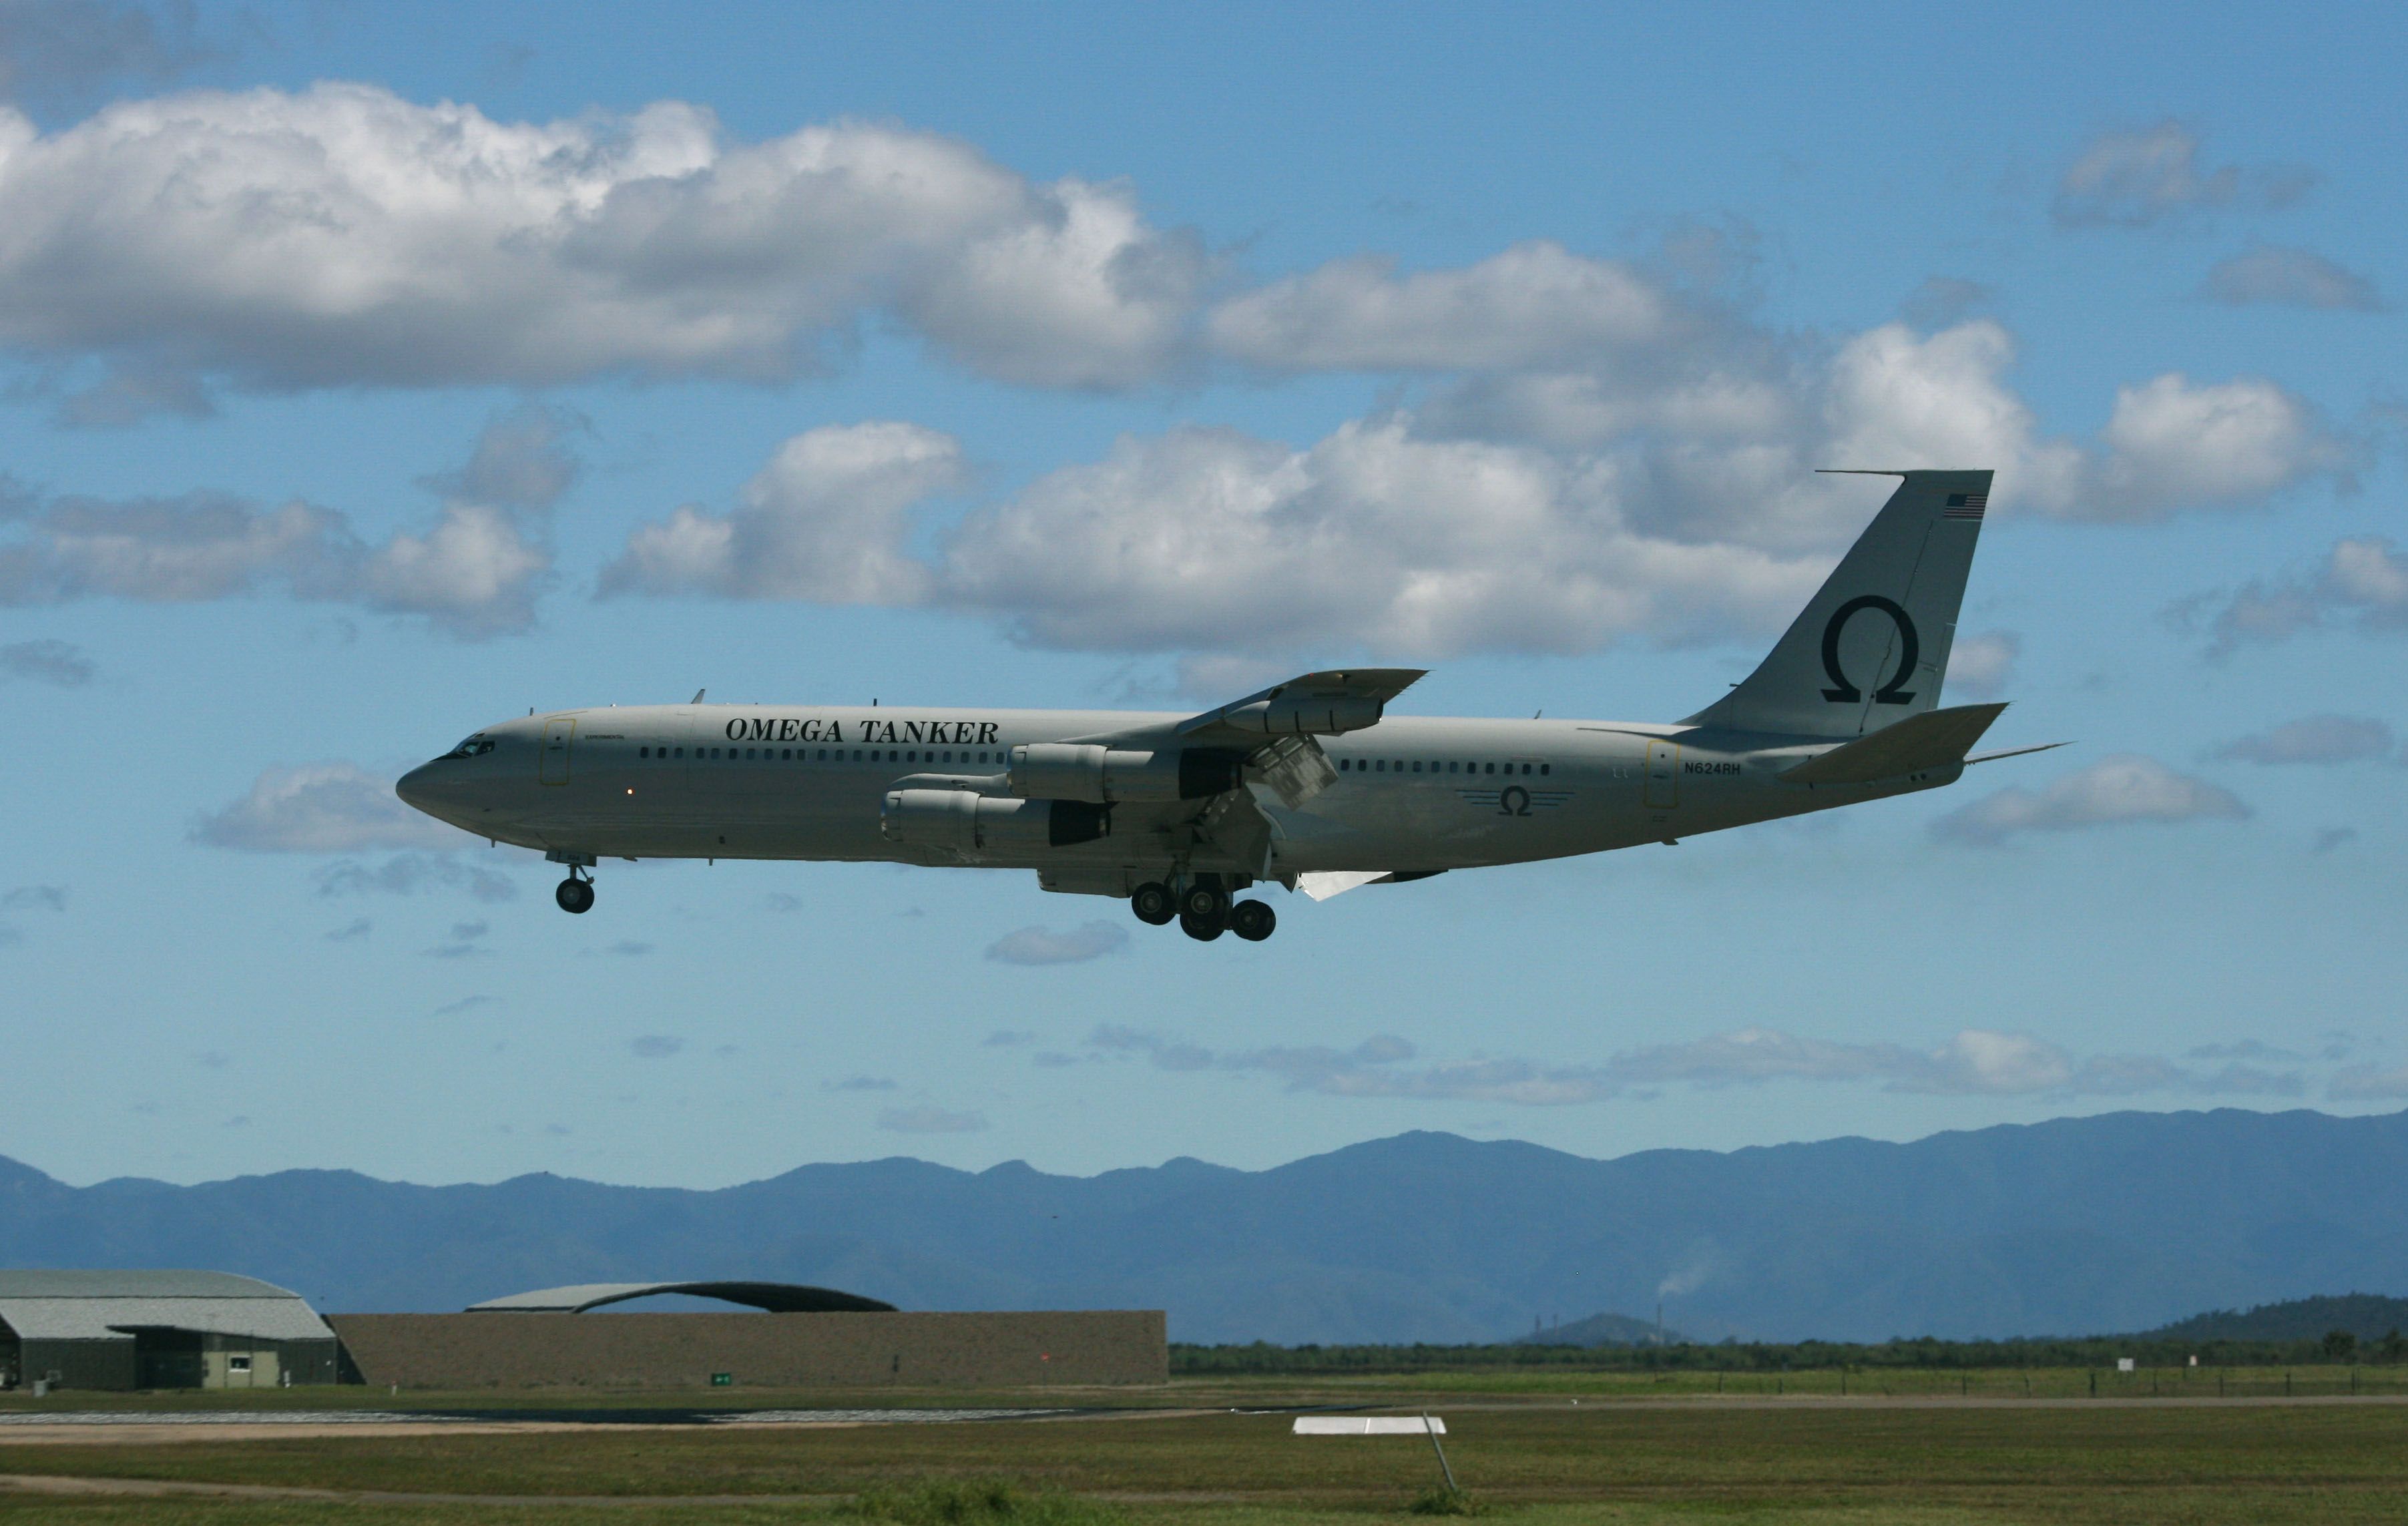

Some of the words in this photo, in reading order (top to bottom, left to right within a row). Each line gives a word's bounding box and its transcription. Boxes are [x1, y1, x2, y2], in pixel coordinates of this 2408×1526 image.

[725, 718, 844, 742] OMEGA
[859, 720, 999, 745] TANKER
[1684, 762, 1740, 775] N624RH
